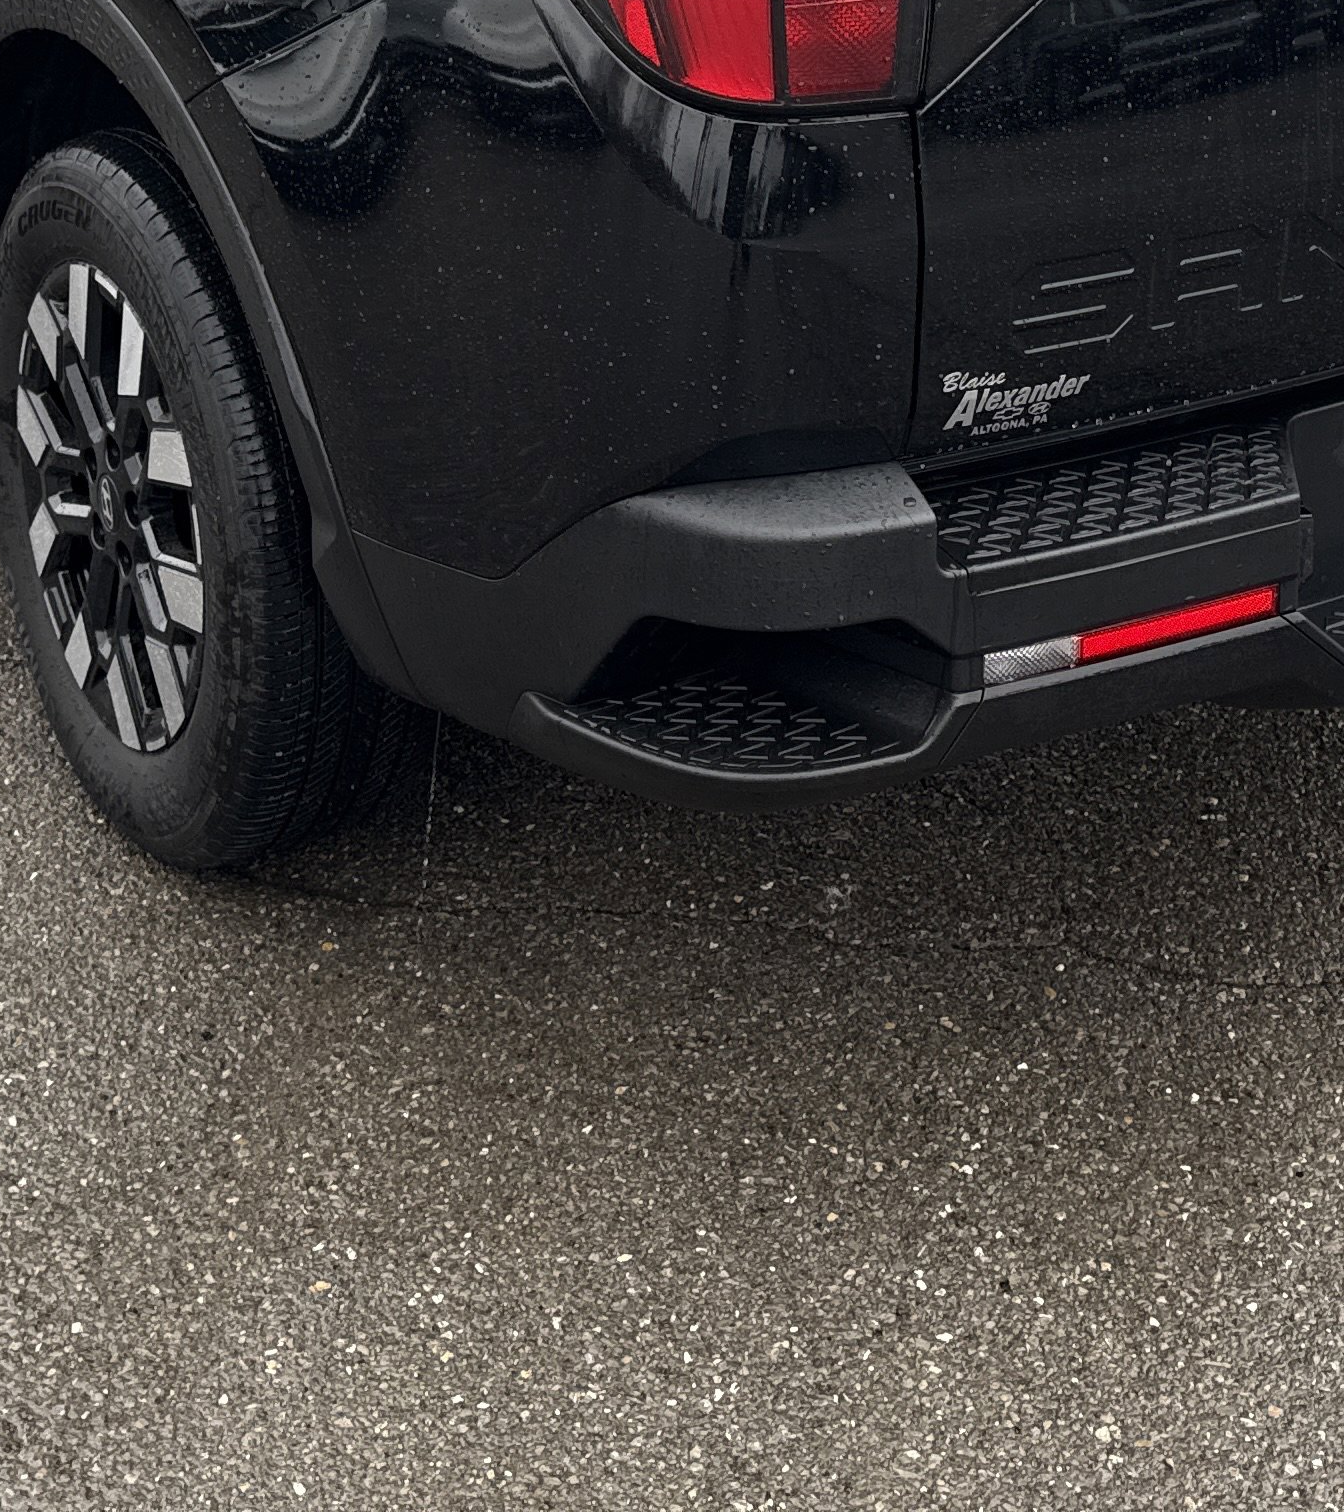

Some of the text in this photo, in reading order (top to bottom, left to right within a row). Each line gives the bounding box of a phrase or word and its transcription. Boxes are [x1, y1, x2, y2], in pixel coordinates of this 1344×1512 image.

[942, 371, 1007, 393] Blaise
[942, 374, 1091, 431] Alexander
[970, 413, 1048, 437] ALTOONA, PA
